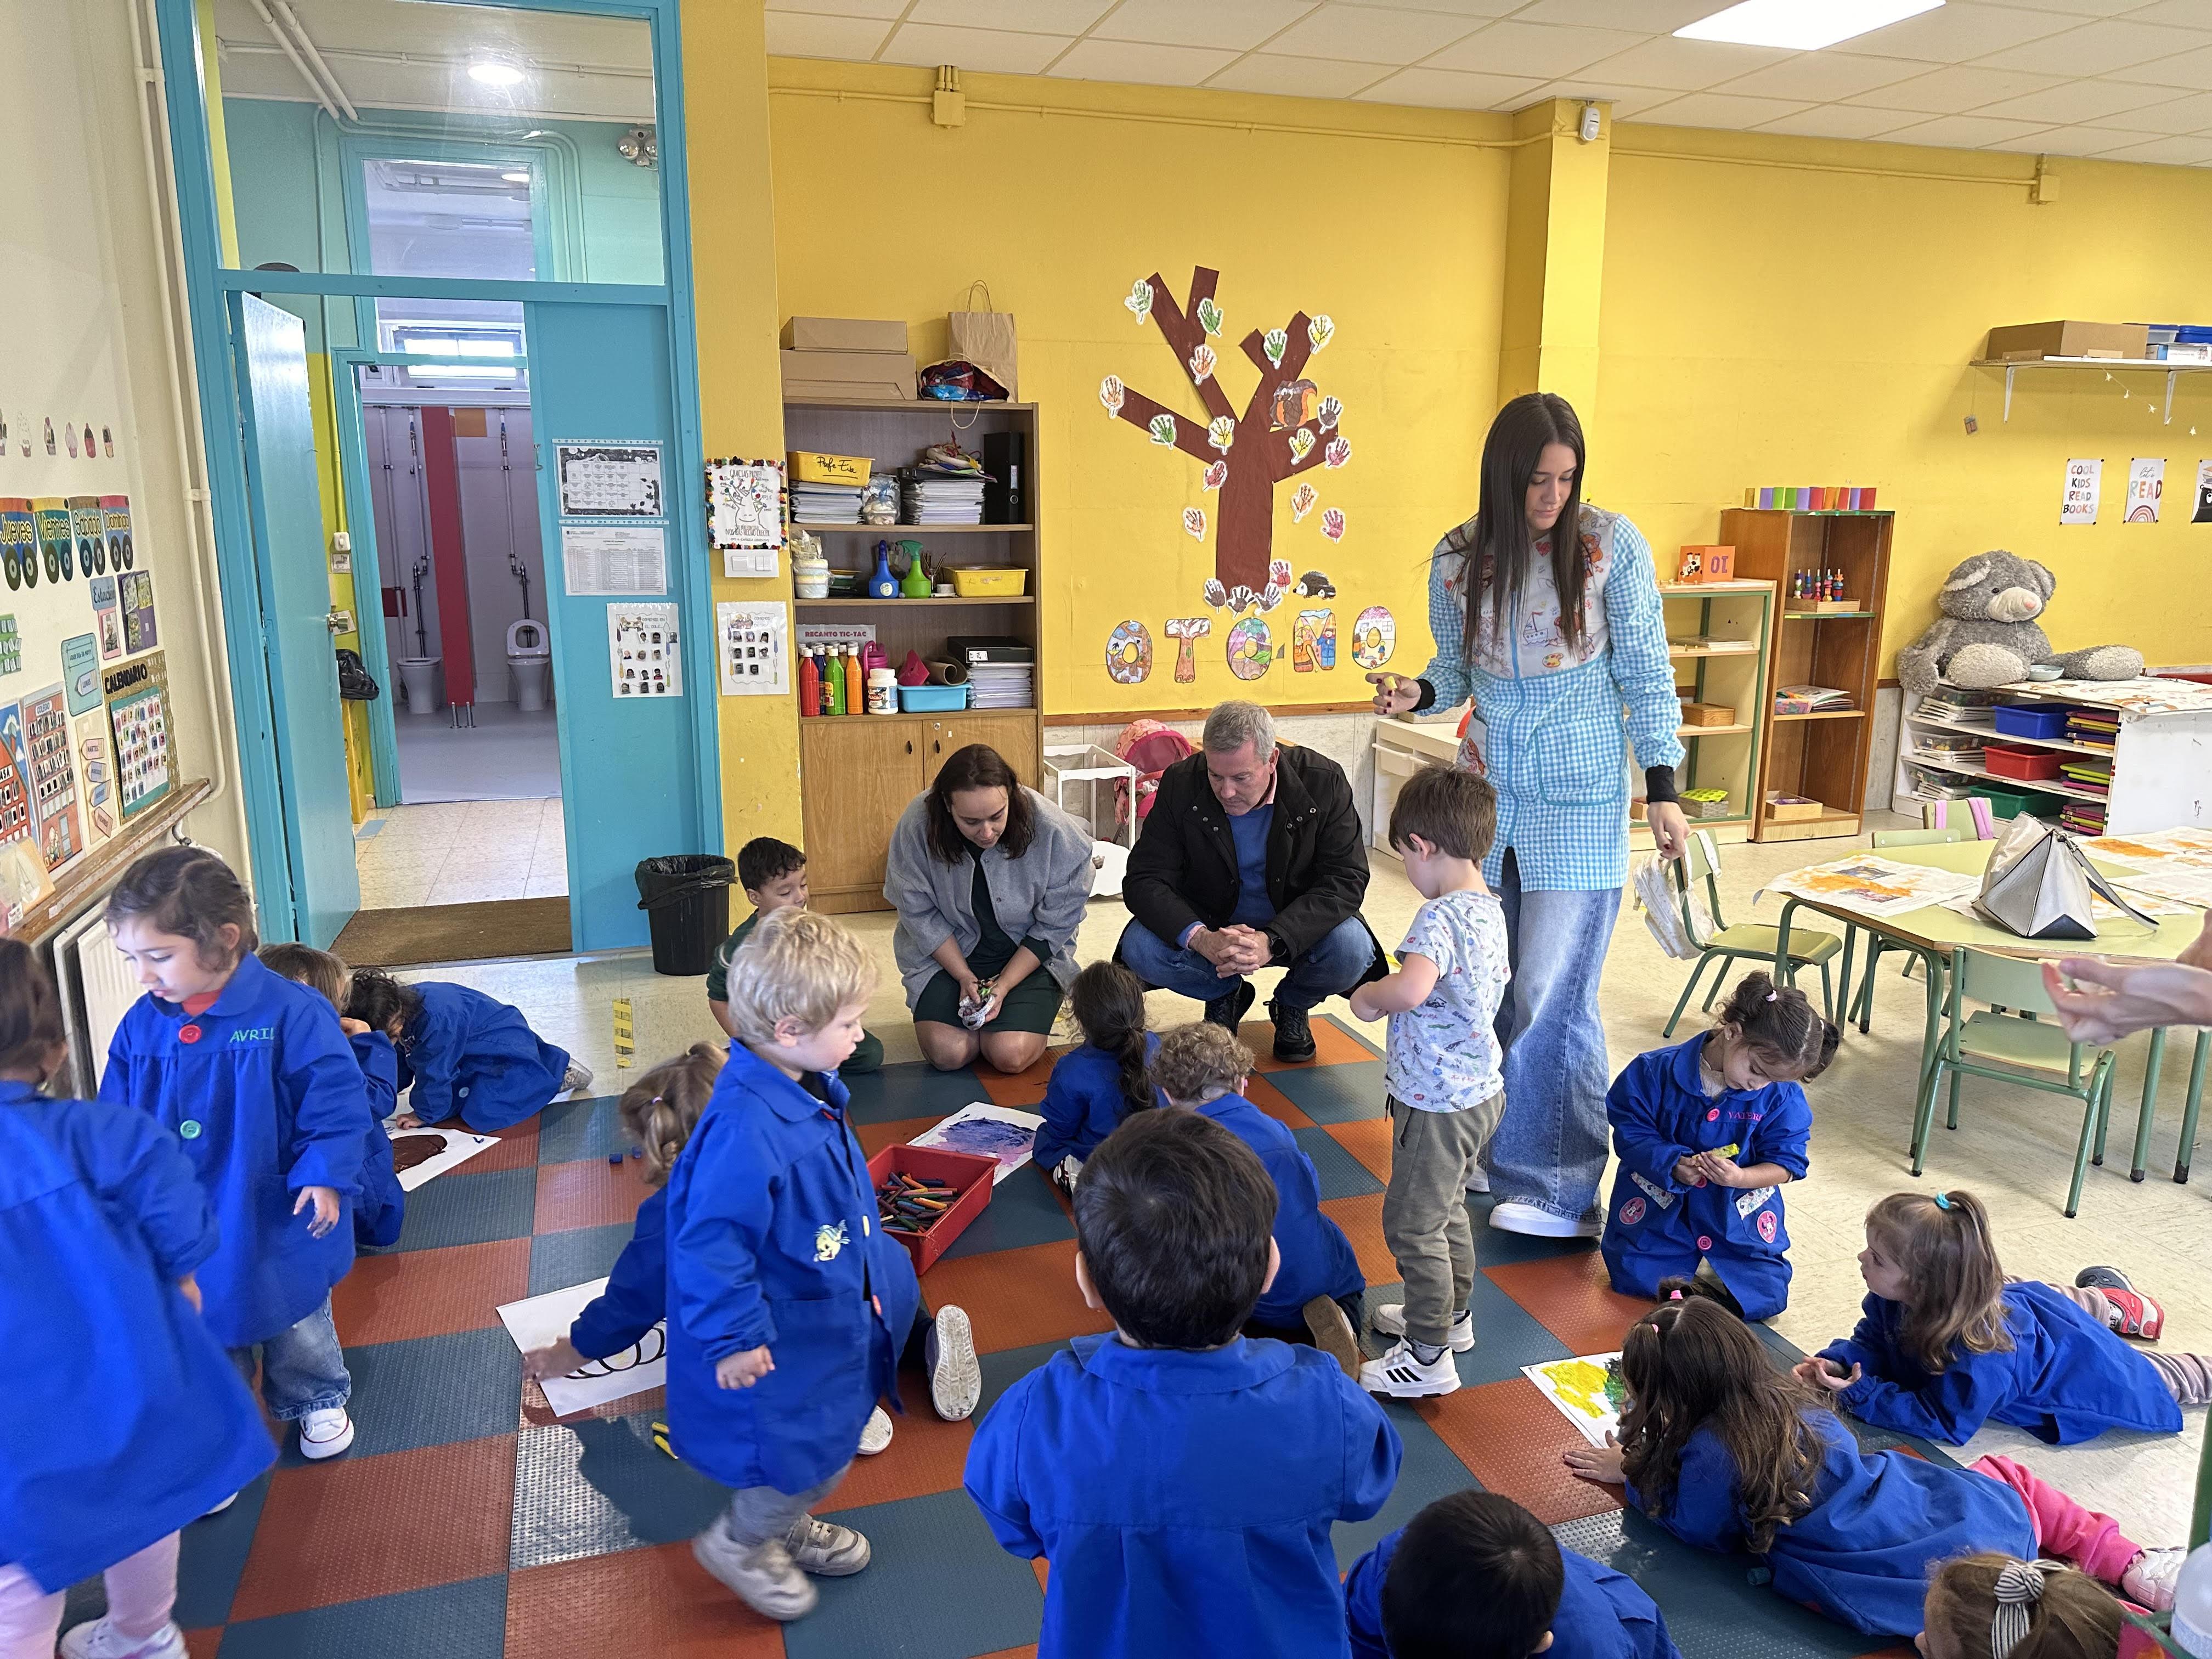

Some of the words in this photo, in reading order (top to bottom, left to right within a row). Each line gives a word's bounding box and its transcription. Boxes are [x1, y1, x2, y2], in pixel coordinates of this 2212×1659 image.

[816, 456, 837, 472] Profe
[837, 459, 856, 473] Eva
[2071, 465, 2094, 475] COOL
[730, 469, 748, 478] GRACIAS
[2072, 478, 2091, 488] KIDS
[2130, 479, 2162, 500] READ
[2069, 491, 2091, 501] READ
[2063, 504, 2094, 514] BOOKS
[1, 513, 33, 544] Jueves
[37, 512, 70, 540] Viernes
[104, 510, 129, 533] Domingo
[104, 663, 148, 695] CALENDARIO
[36, 702, 50, 714] COLEGIO
[0, 767, 10, 780] ASA
[229, 1027, 274, 1043] AVRIL
